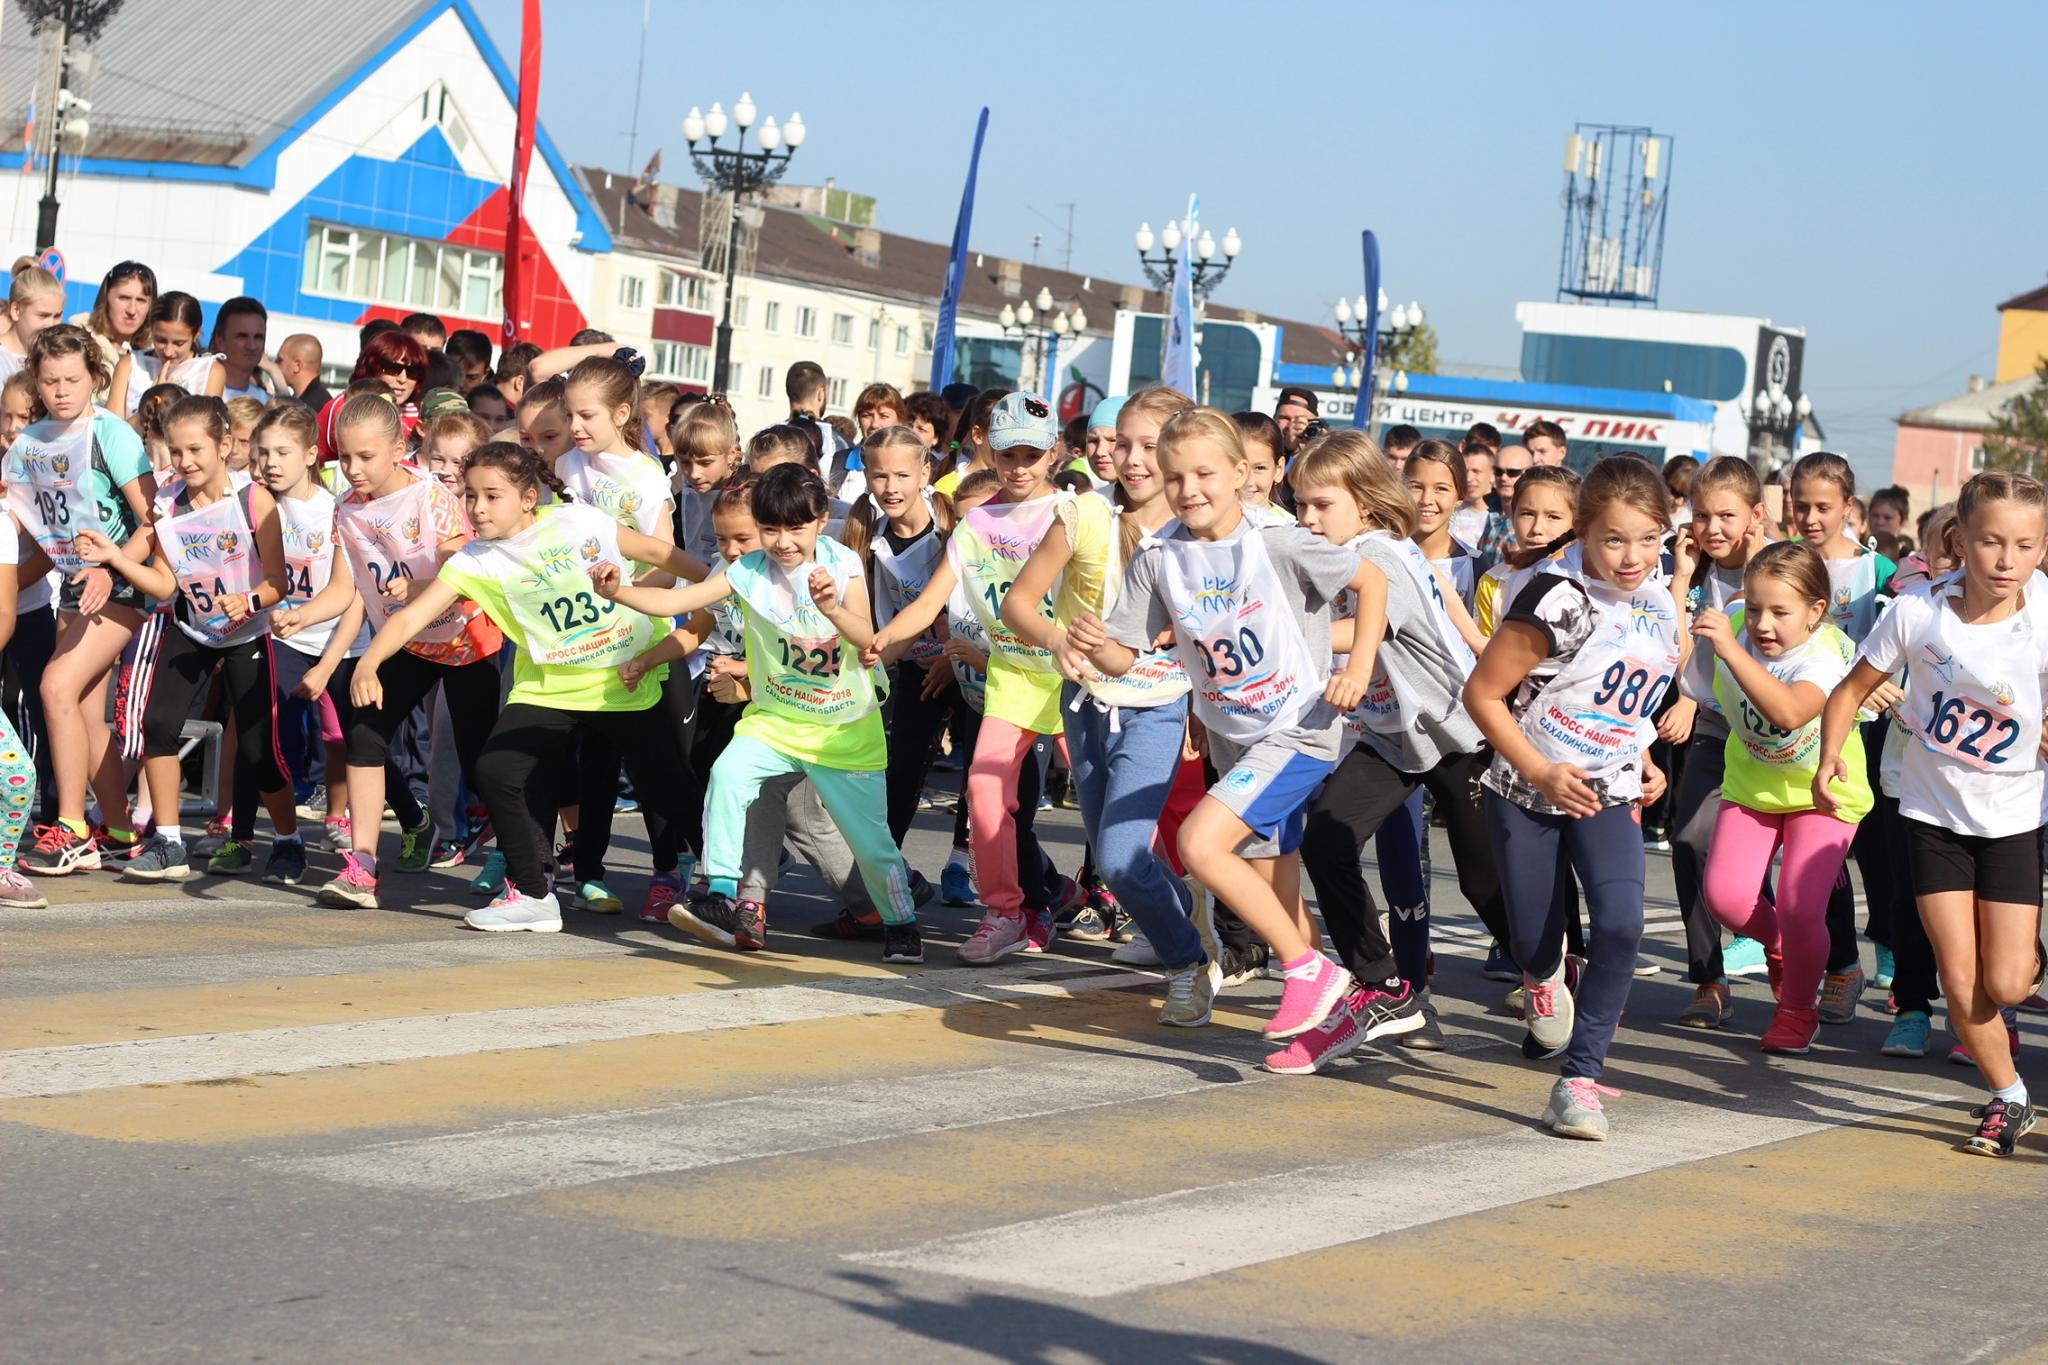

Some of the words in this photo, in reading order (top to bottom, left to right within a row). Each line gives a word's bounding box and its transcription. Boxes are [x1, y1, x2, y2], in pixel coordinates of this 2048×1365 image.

[1402, 406, 1474, 425] ЦЕНТР
[1583, 419, 1664, 441] ПИК
[35, 490, 70, 525] 193
[545, 647, 577, 662] КРОСС
[579, 636, 611, 654] НАЦИИ
[794, 690, 826, 706] НАЦИИ
[831, 688, 852, 704] 2018
[1593, 660, 1671, 719] 980
[817, 699, 856, 716] ОБЛАСТЬ
[1539, 716, 1605, 757] САХАЛИНСКАЯ
[1547, 705, 1584, 736] КРОСС
[1584, 728, 1621, 749] НАЦИИ
[1924, 690, 2021, 765] 1622
